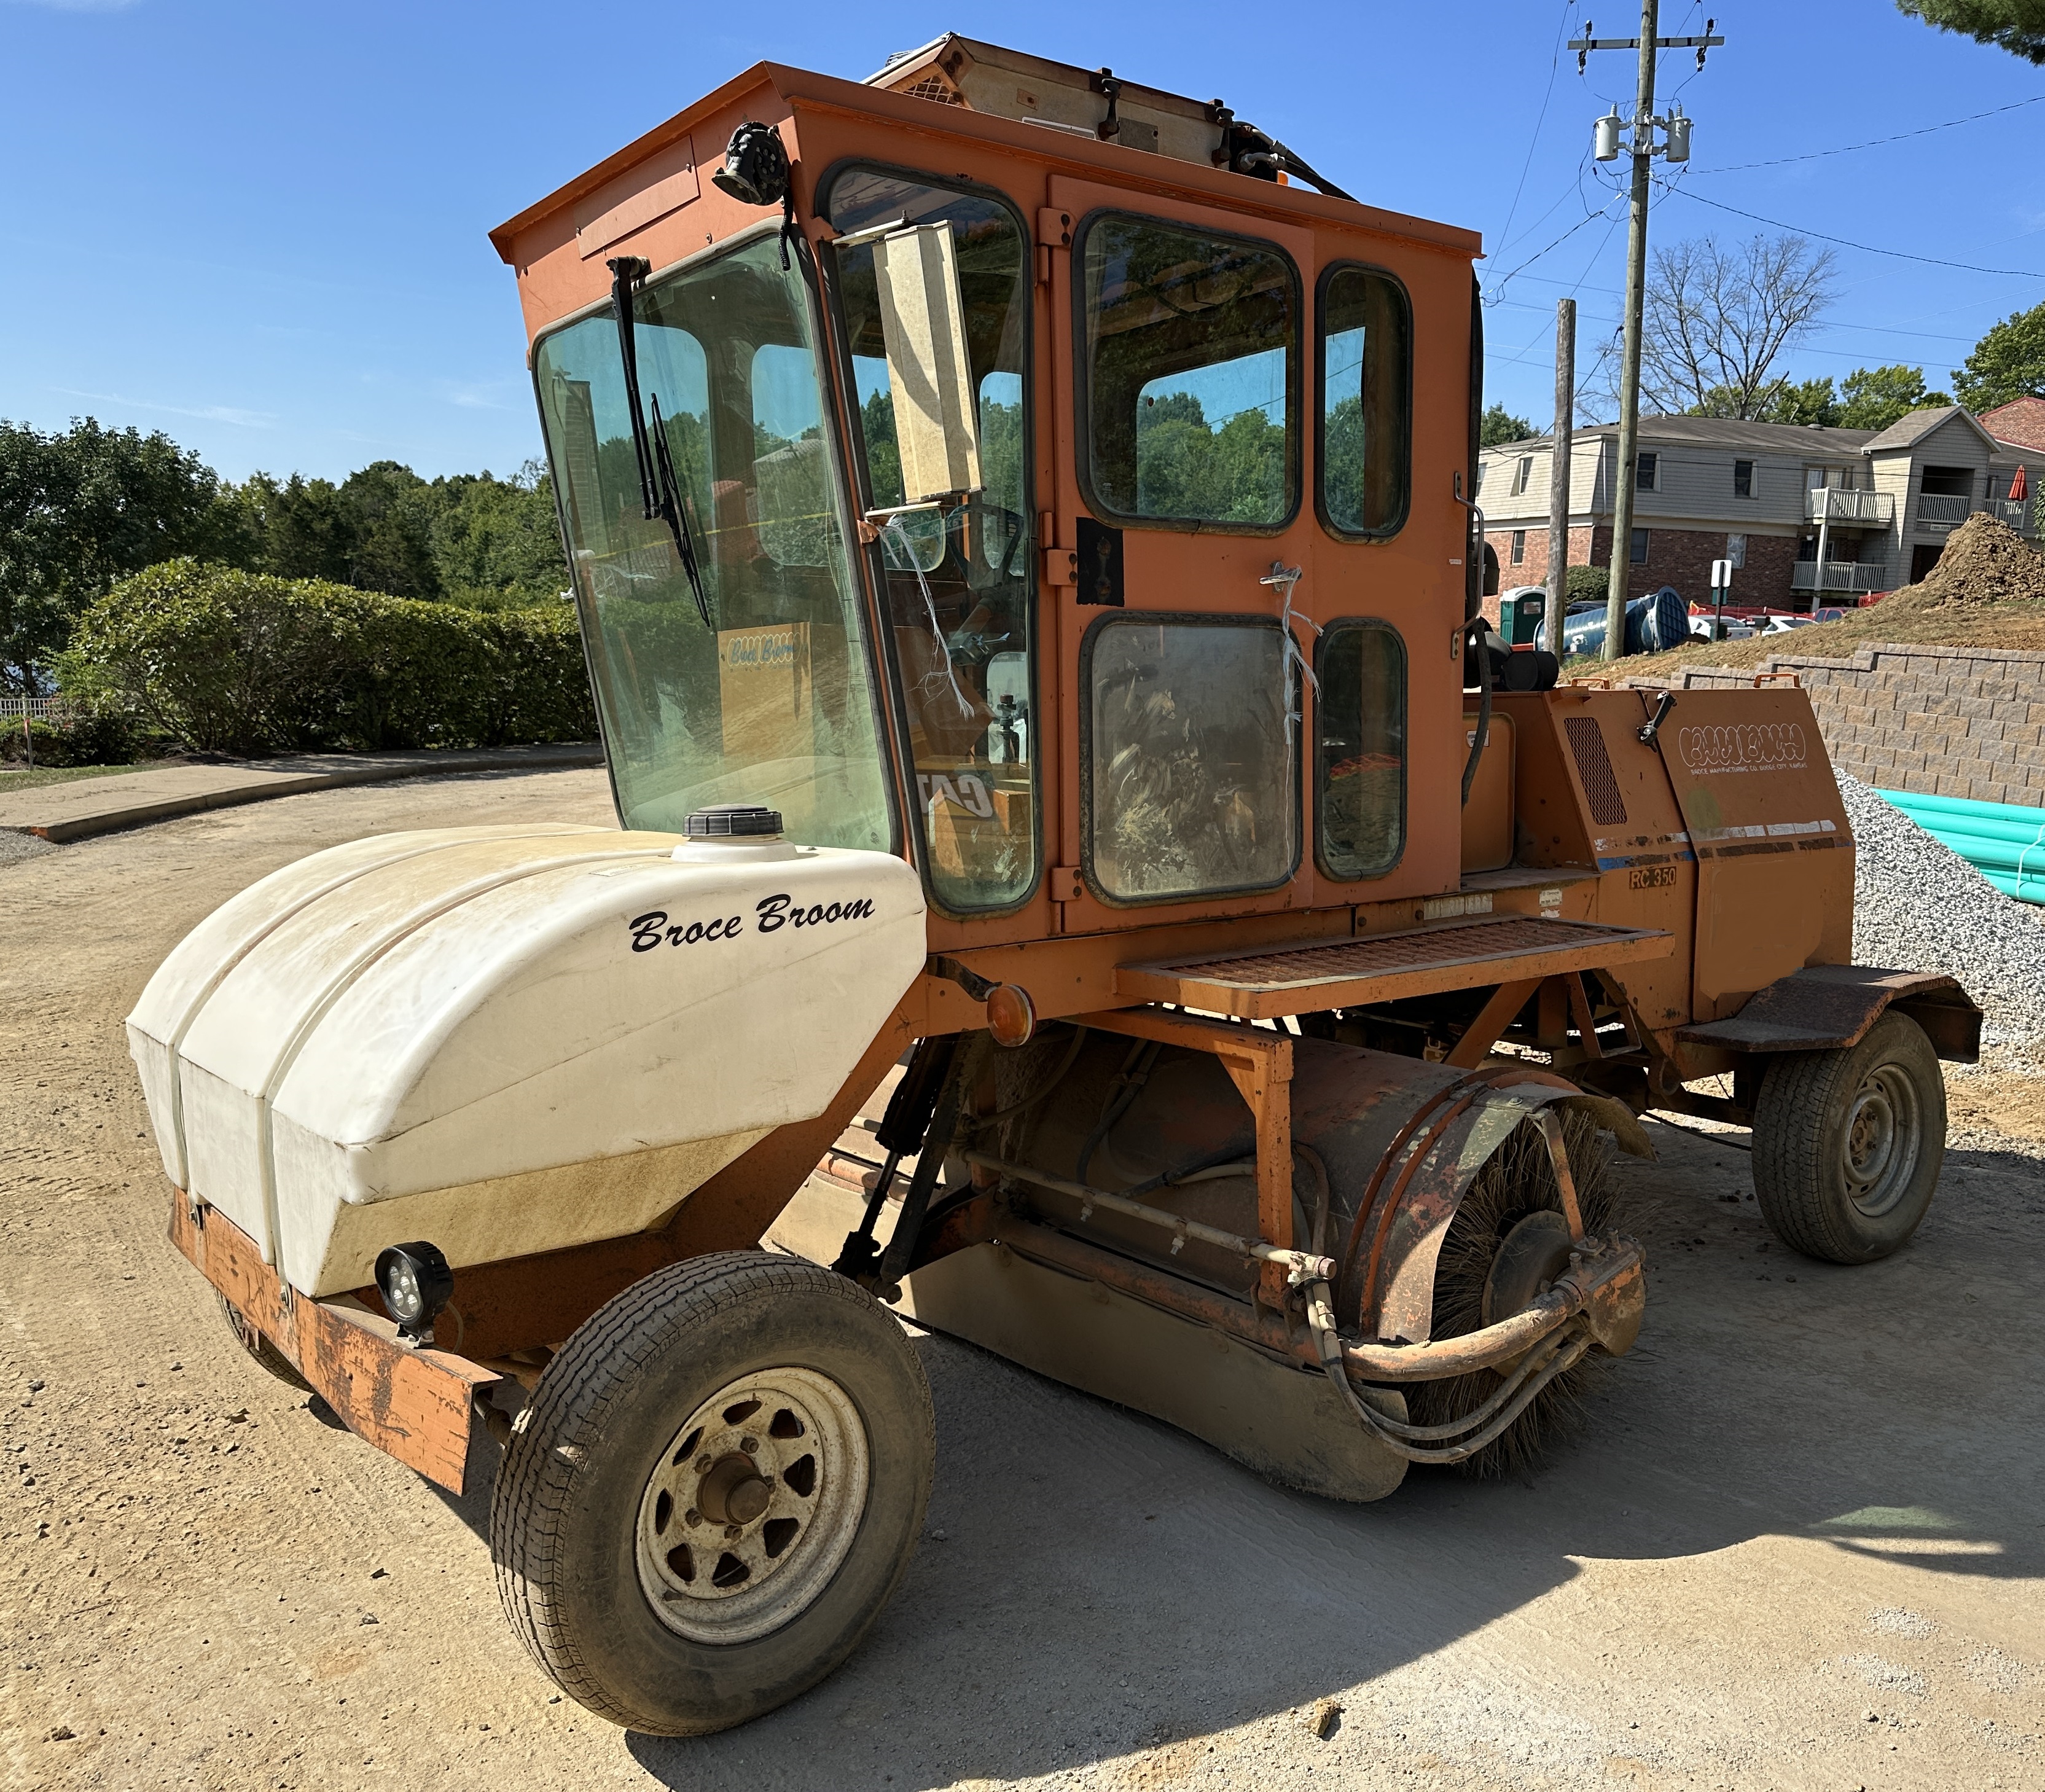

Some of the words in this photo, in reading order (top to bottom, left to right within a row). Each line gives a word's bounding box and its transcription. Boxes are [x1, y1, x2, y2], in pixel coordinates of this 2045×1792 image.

[1631, 870, 1650, 888] RC
[1654, 867, 1676, 886] 350
[628, 911, 743, 952] Broce
[756, 893, 875, 933] Broom
